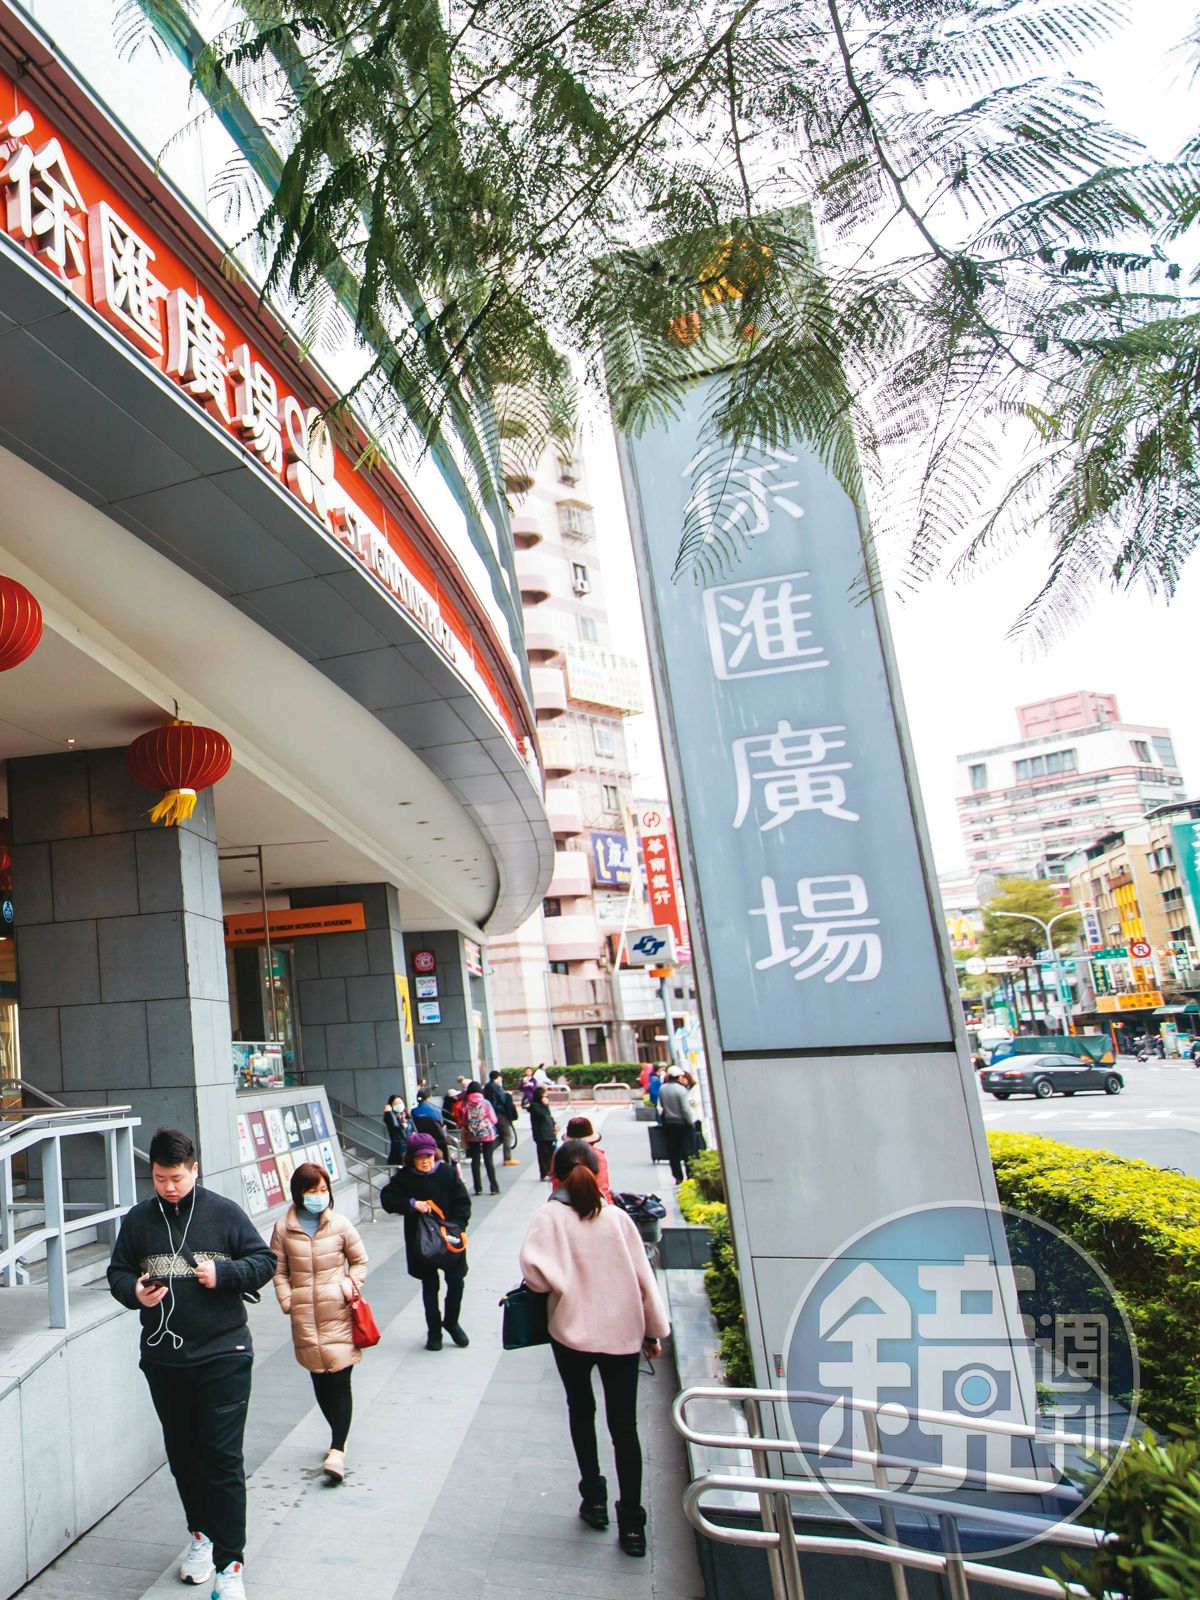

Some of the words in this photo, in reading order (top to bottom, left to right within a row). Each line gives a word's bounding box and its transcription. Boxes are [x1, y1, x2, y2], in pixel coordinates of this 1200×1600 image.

[7, 110, 284, 474] 徐匯廣場
[681, 438, 882, 983] 徐匯廣場
